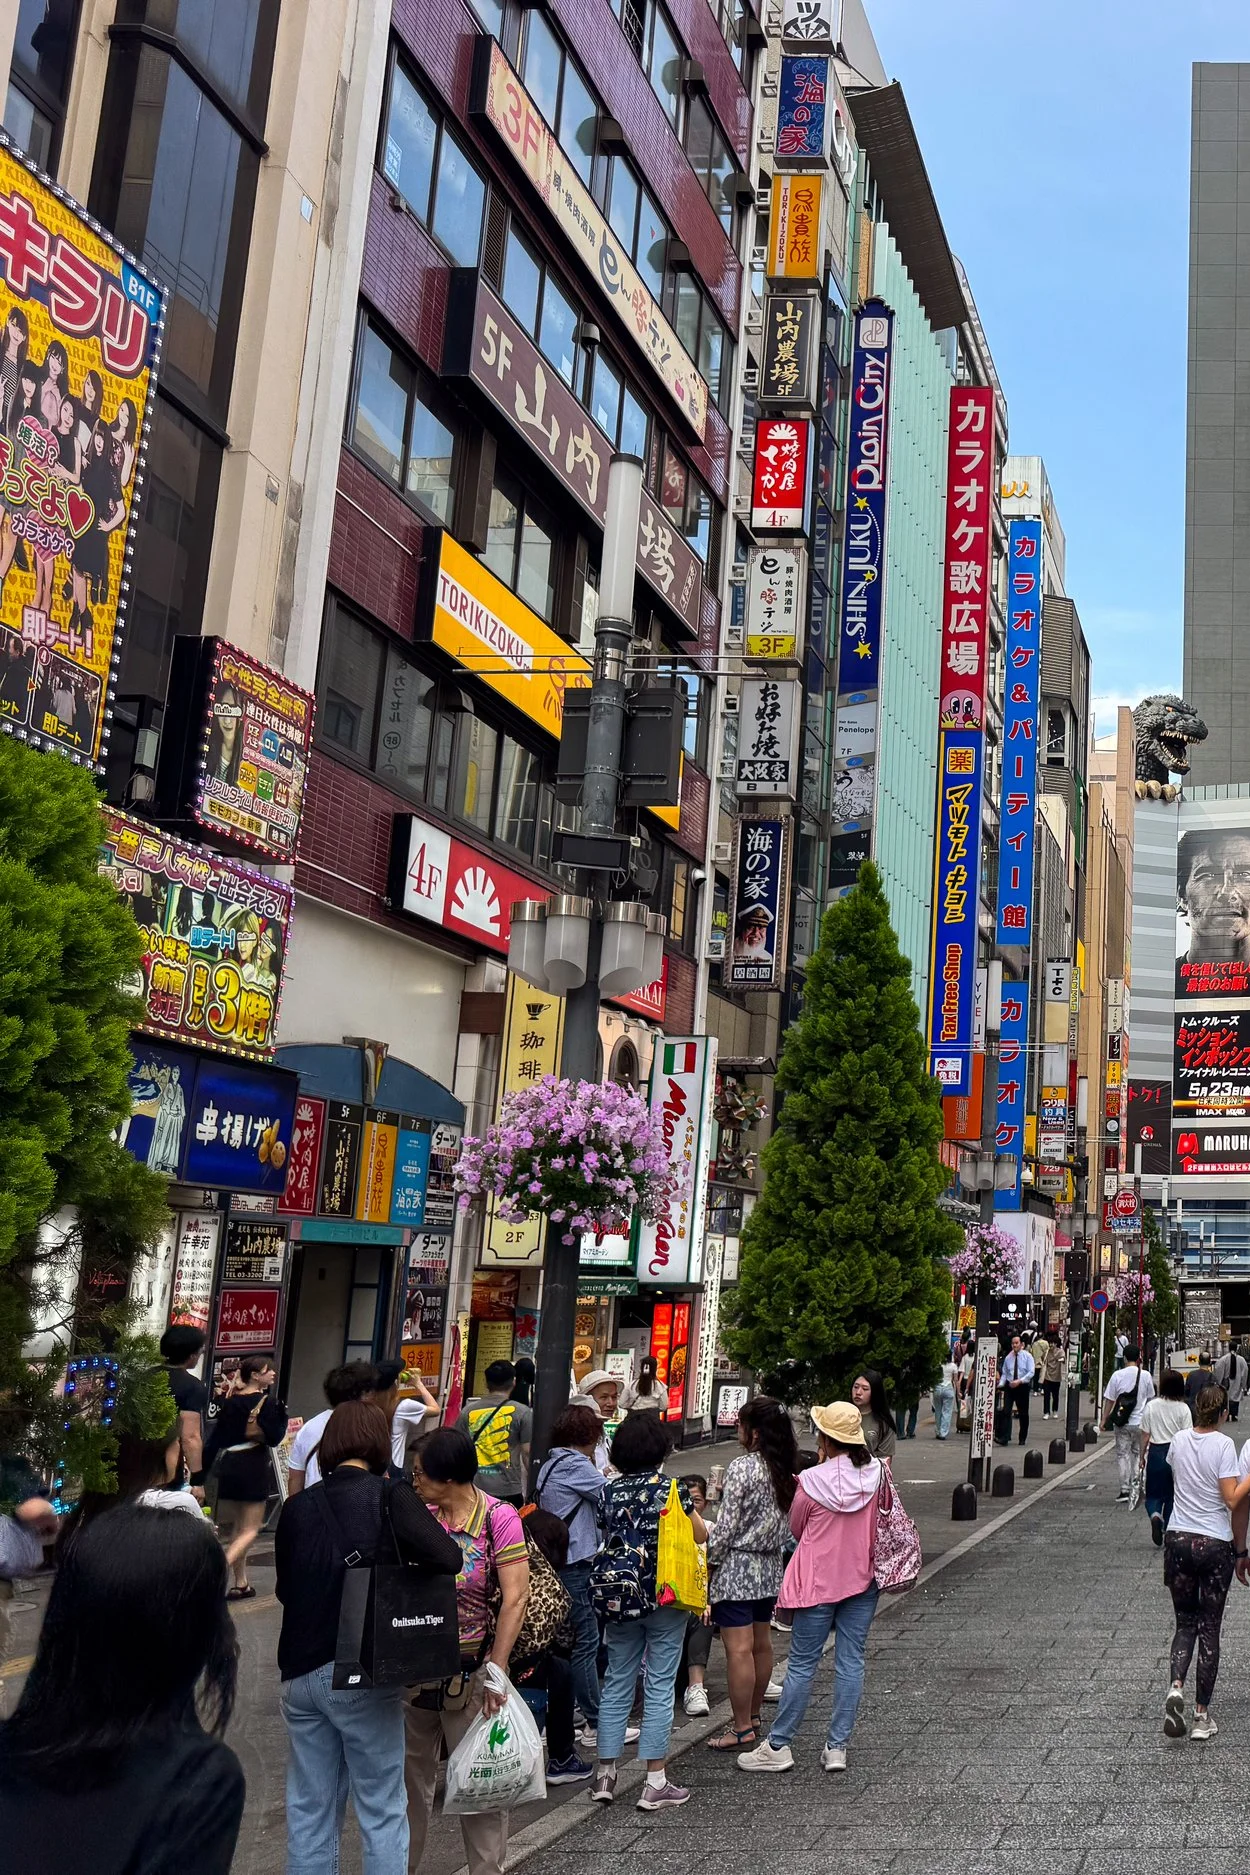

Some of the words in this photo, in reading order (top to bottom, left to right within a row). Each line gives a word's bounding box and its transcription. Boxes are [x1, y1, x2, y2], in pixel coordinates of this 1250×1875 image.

[502, 82, 541, 161] 3F
[778, 72, 826, 154] 海の家
[778, 187, 789, 263] TORIKIZOKU
[789, 188, 813, 264] 鳥貴族
[0, 190, 149, 374] キラリ
[128, 275, 156, 309] B1F
[479, 313, 515, 381] 5F
[769, 301, 803, 385] 山内農場
[777, 385, 793, 396] 5F
[759, 444, 780, 505] さかい
[779, 440, 802, 491] 焼肉屋
[765, 510, 789, 527] 4F
[946, 399, 986, 676] カラオケ歌広場
[846, 513, 878, 637] SHINJUKU
[439, 573, 526, 667] TORIKIZOKU
[758, 637, 785, 654] 3F
[751, 682, 783, 759] お好み焼
[838, 727, 875, 735] Penelope
[841, 748, 852, 756] 7F
[949, 749, 972, 772] 薬
[740, 762, 787, 781] 大阪家
[408, 842, 442, 900] 4F
[743, 826, 774, 900] 海の家
[943, 943, 962, 982] Shop
[942, 983, 960, 1014] Free
[940, 1015, 957, 1042] Tax
[1176, 1027, 1239, 1048] ミッション:
[1181, 1015, 1240, 1027] トム・クルーズ
[518, 1031, 545, 1080] 珈琲
[995, 997, 1023, 1146] カラオケ
[341, 1105, 351, 1118] 5F
[376, 1111, 388, 1124] 6F
[1042, 1099, 1066, 1107] つり具
[195, 1100, 271, 1151] 串揚げ
[410, 1119, 421, 1131] 7F
[434, 1131, 457, 1148] ダーツ
[421, 1234, 447, 1250] ダーツ
[505, 1231, 525, 1243] 2F
[391, 1616, 425, 1628] Onitsuka
[425, 1613, 445, 1626] Tiger
